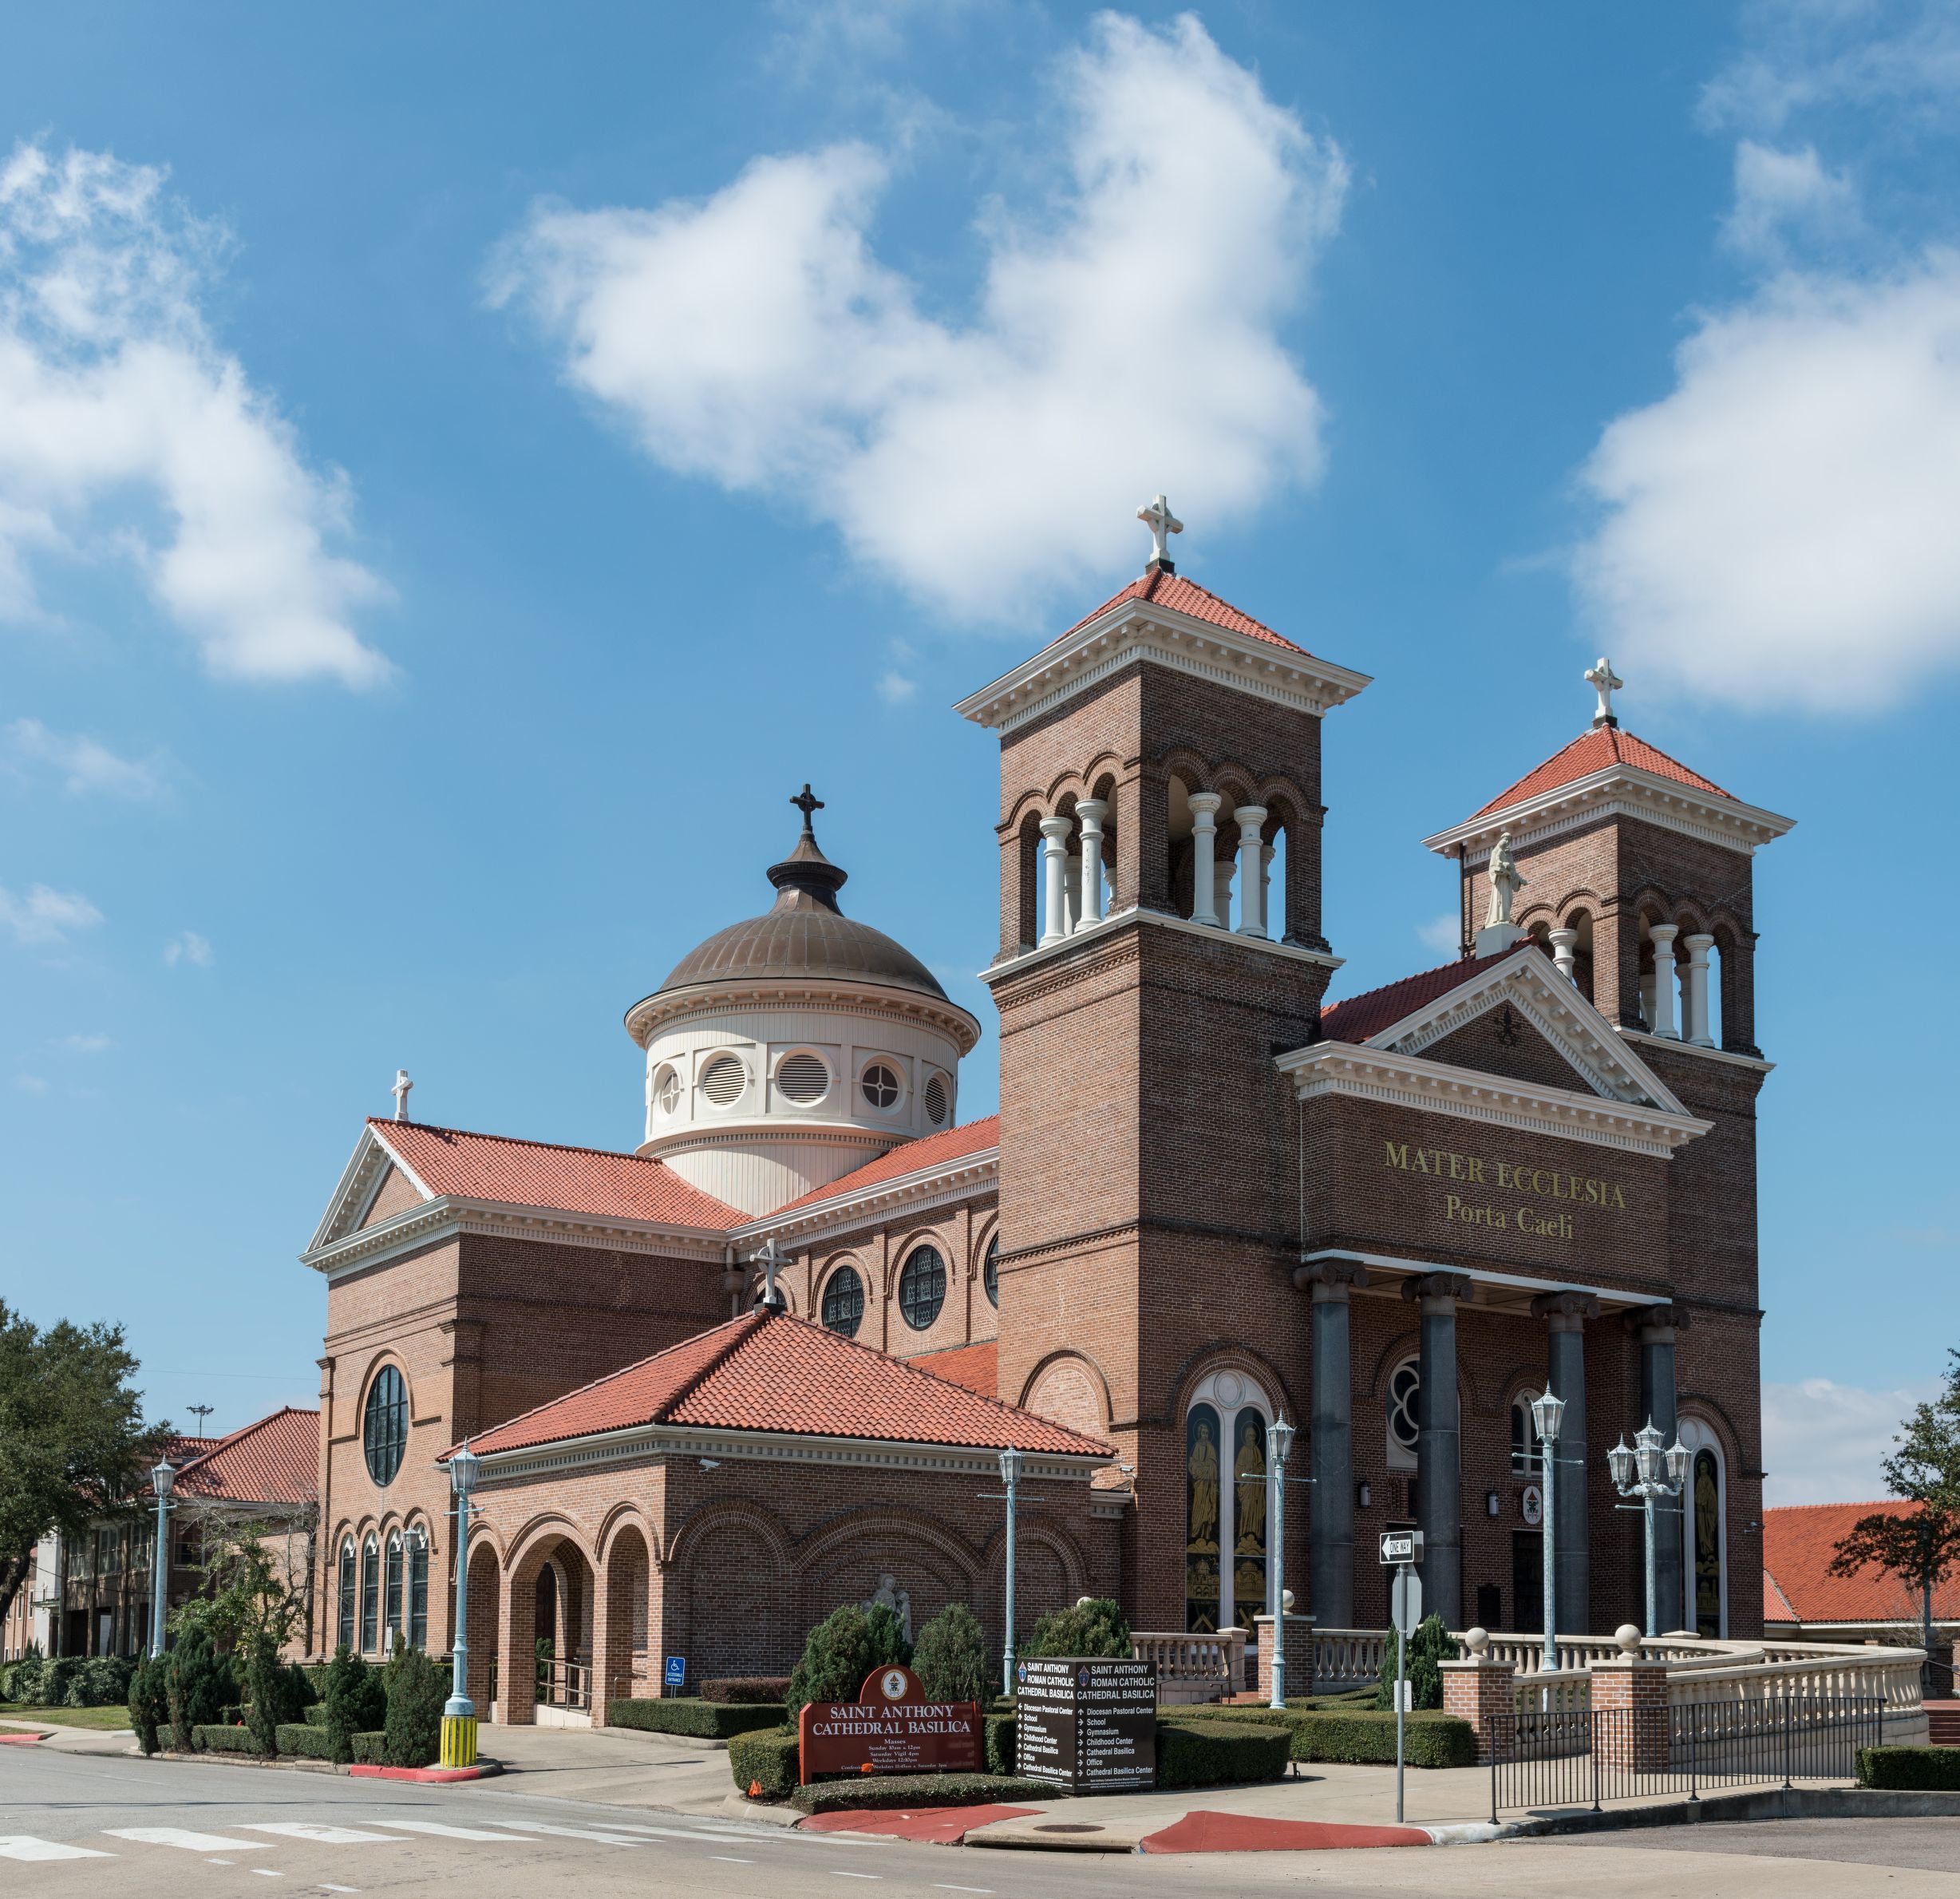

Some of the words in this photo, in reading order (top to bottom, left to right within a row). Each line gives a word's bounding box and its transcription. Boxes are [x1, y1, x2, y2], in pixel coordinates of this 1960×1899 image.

[1384, 1141, 1485, 1184] MATER
[1496, 1161, 1626, 1209] ECCLESIA
[1444, 1196, 1507, 1228] Porta
[1517, 1208, 1573, 1239] Caeli
[1389, 1542, 1399, 1553] ONE
[1400, 1541, 1410, 1553] WAY
[1027, 1662, 1043, 1672] SAINT
[1043, 1664, 1069, 1674] ANTHONY
[1091, 1665, 1112, 1674] SAINT
[1114, 1665, 1148, 1674] ANTHONY
[1027, 1675, 1046, 1684] ROMAN
[1047, 1676, 1074, 1687] CATHOLIC
[1091, 1678, 1117, 1687] ROMAN
[1119, 1677, 1155, 1687] CATHOLIC
[1018, 1686, 1048, 1697] CATHEDRAL
[1049, 1688, 1074, 1699] BASILICA
[1077, 1691, 1120, 1699] CATHEDRAL
[1122, 1690, 1155, 1699] BASILICA
[830, 1707, 875, 1719] SAINT
[881, 1705, 954, 1718] ANTHONY
[1024, 1703, 1041, 1712] Diocesan
[1024, 1713, 1037, 1722] School
[812, 1722, 903, 1735] CATHEDRAL
[908, 1720, 970, 1734] BASILICA
[1024, 1723, 1047, 1733] Gymnasium
[1086, 1728, 1119, 1737] Gymnasium
[1024, 1733, 1043, 1743] Childhood
[1044, 1735, 1057, 1744] Center
[1023, 1743, 1041, 1752] Cathedral
[1042, 1746, 1058, 1755] Basilica
[1023, 1763, 1041, 1772] Cathedral
[1042, 1766, 1058, 1774] Basilica
[1058, 1768, 1073, 1777] Center
